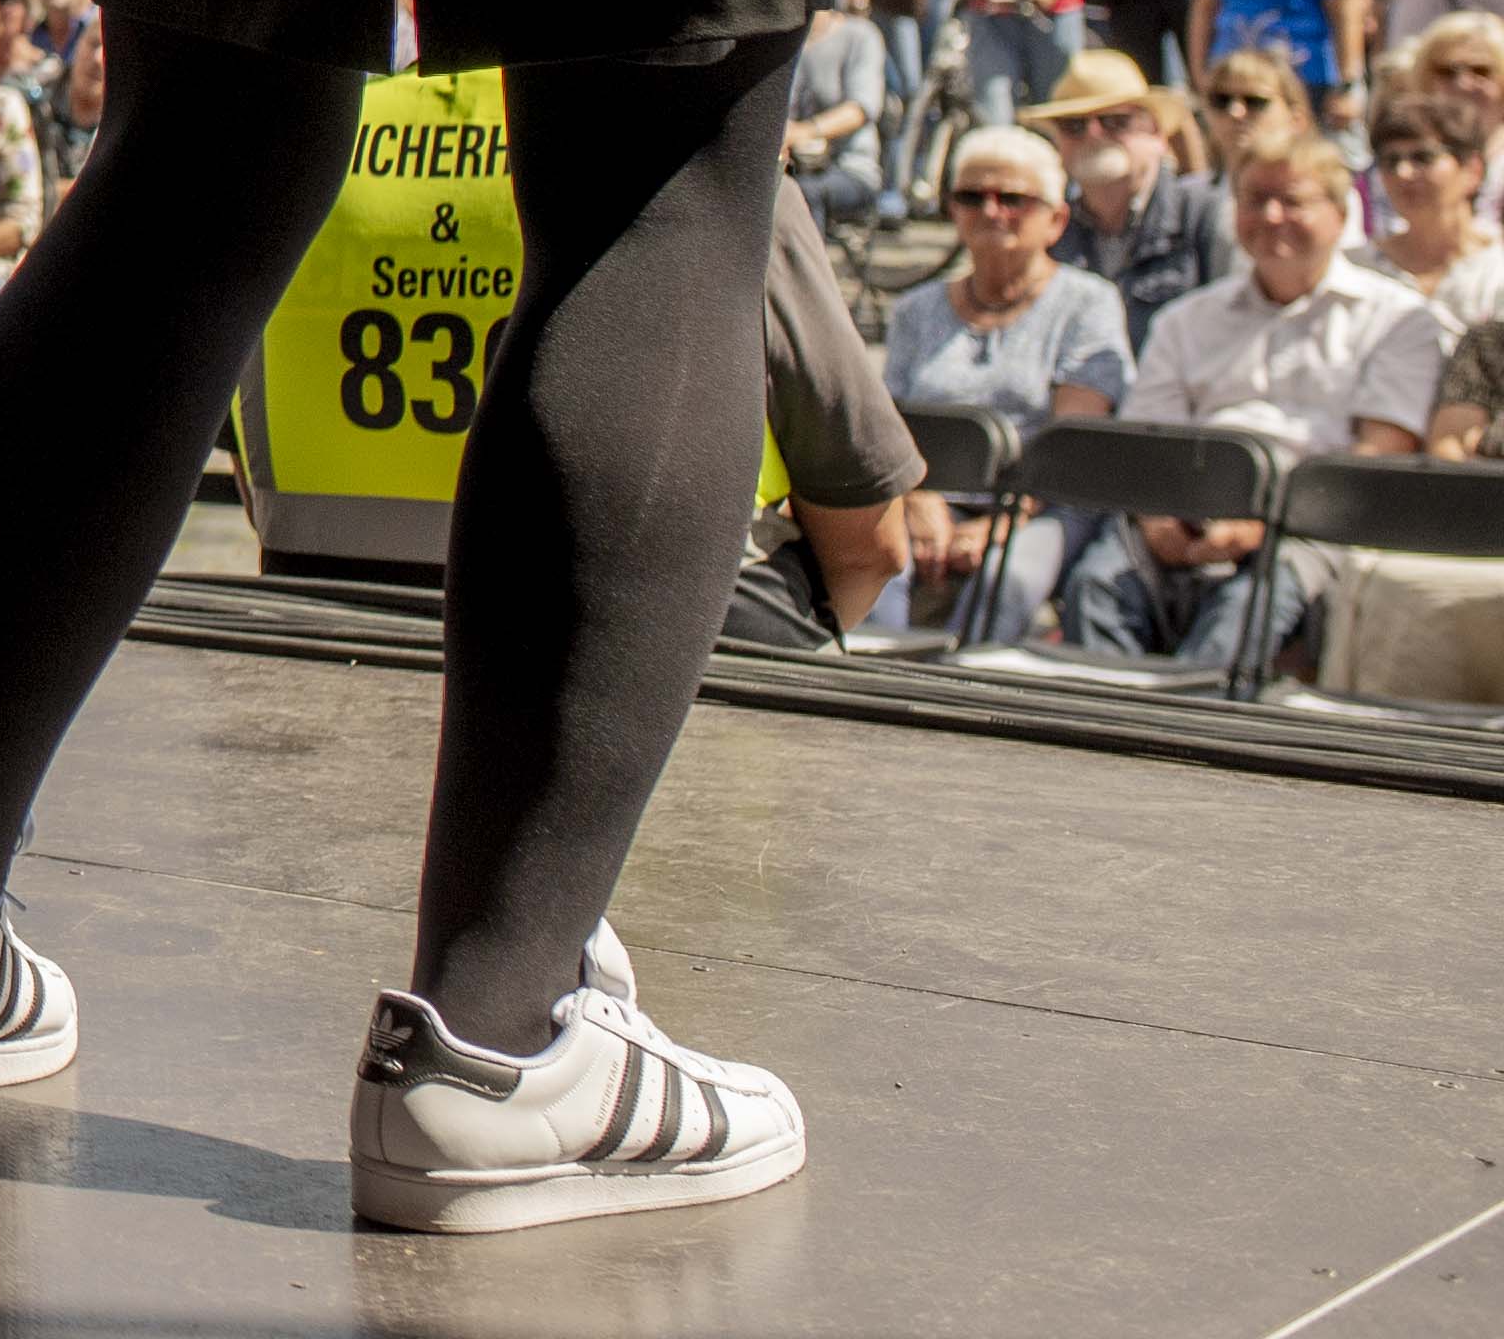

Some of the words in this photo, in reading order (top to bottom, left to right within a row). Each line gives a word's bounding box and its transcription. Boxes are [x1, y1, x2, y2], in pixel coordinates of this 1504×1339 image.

[430, 203, 460, 243] &
[372, 255, 513, 299] Service
[595, 1059, 619, 1127] SUPERSTAR
